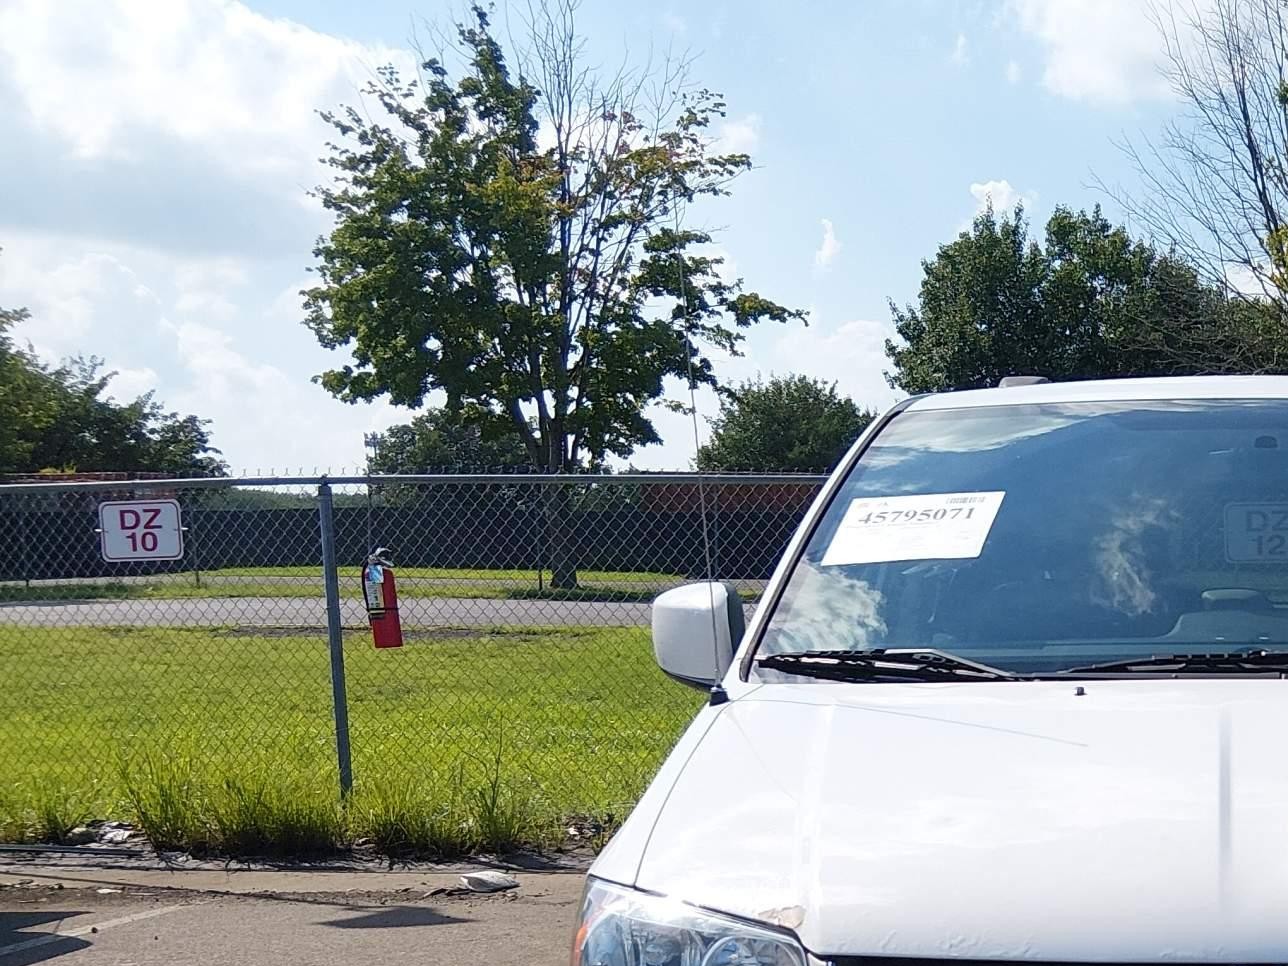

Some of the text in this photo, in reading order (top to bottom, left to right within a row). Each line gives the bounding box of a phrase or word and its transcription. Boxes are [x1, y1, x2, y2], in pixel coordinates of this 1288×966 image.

[119, 508, 162, 531] DZ
[858, 506, 977, 525] 45795071
[126, 532, 158, 552] 10
[1250, 534, 1286, 556] 12
